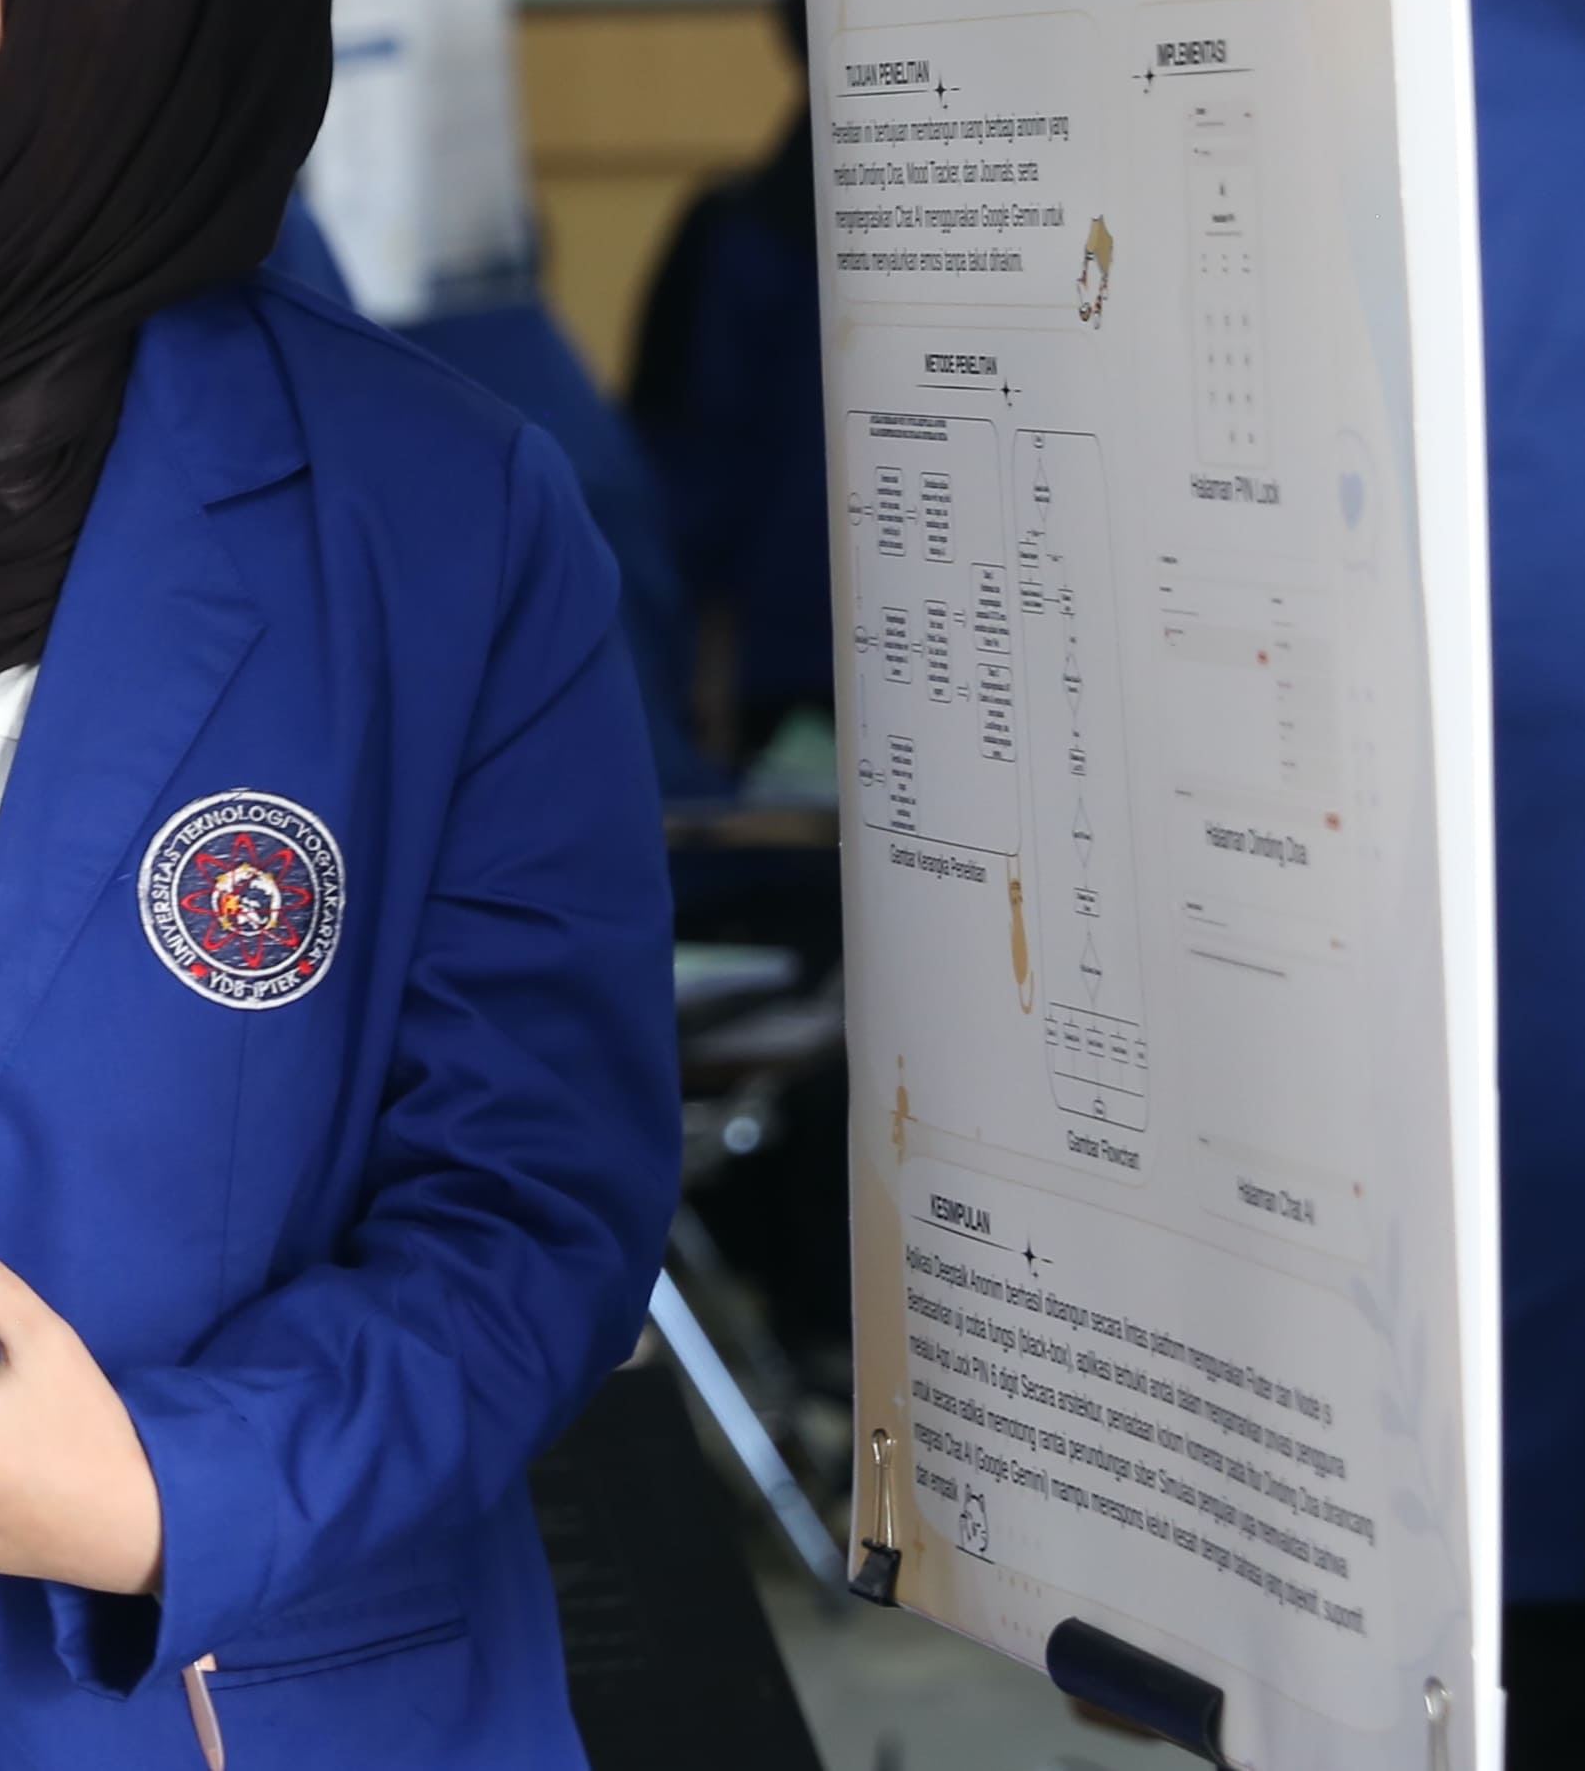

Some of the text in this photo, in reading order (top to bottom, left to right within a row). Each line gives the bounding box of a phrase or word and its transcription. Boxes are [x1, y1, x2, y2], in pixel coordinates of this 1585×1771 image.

[880, 60, 930, 85] PENELITIAN
[150, 804, 339, 966] UNIVERSITAS TEKNOLOGI YOGYAKARTA
